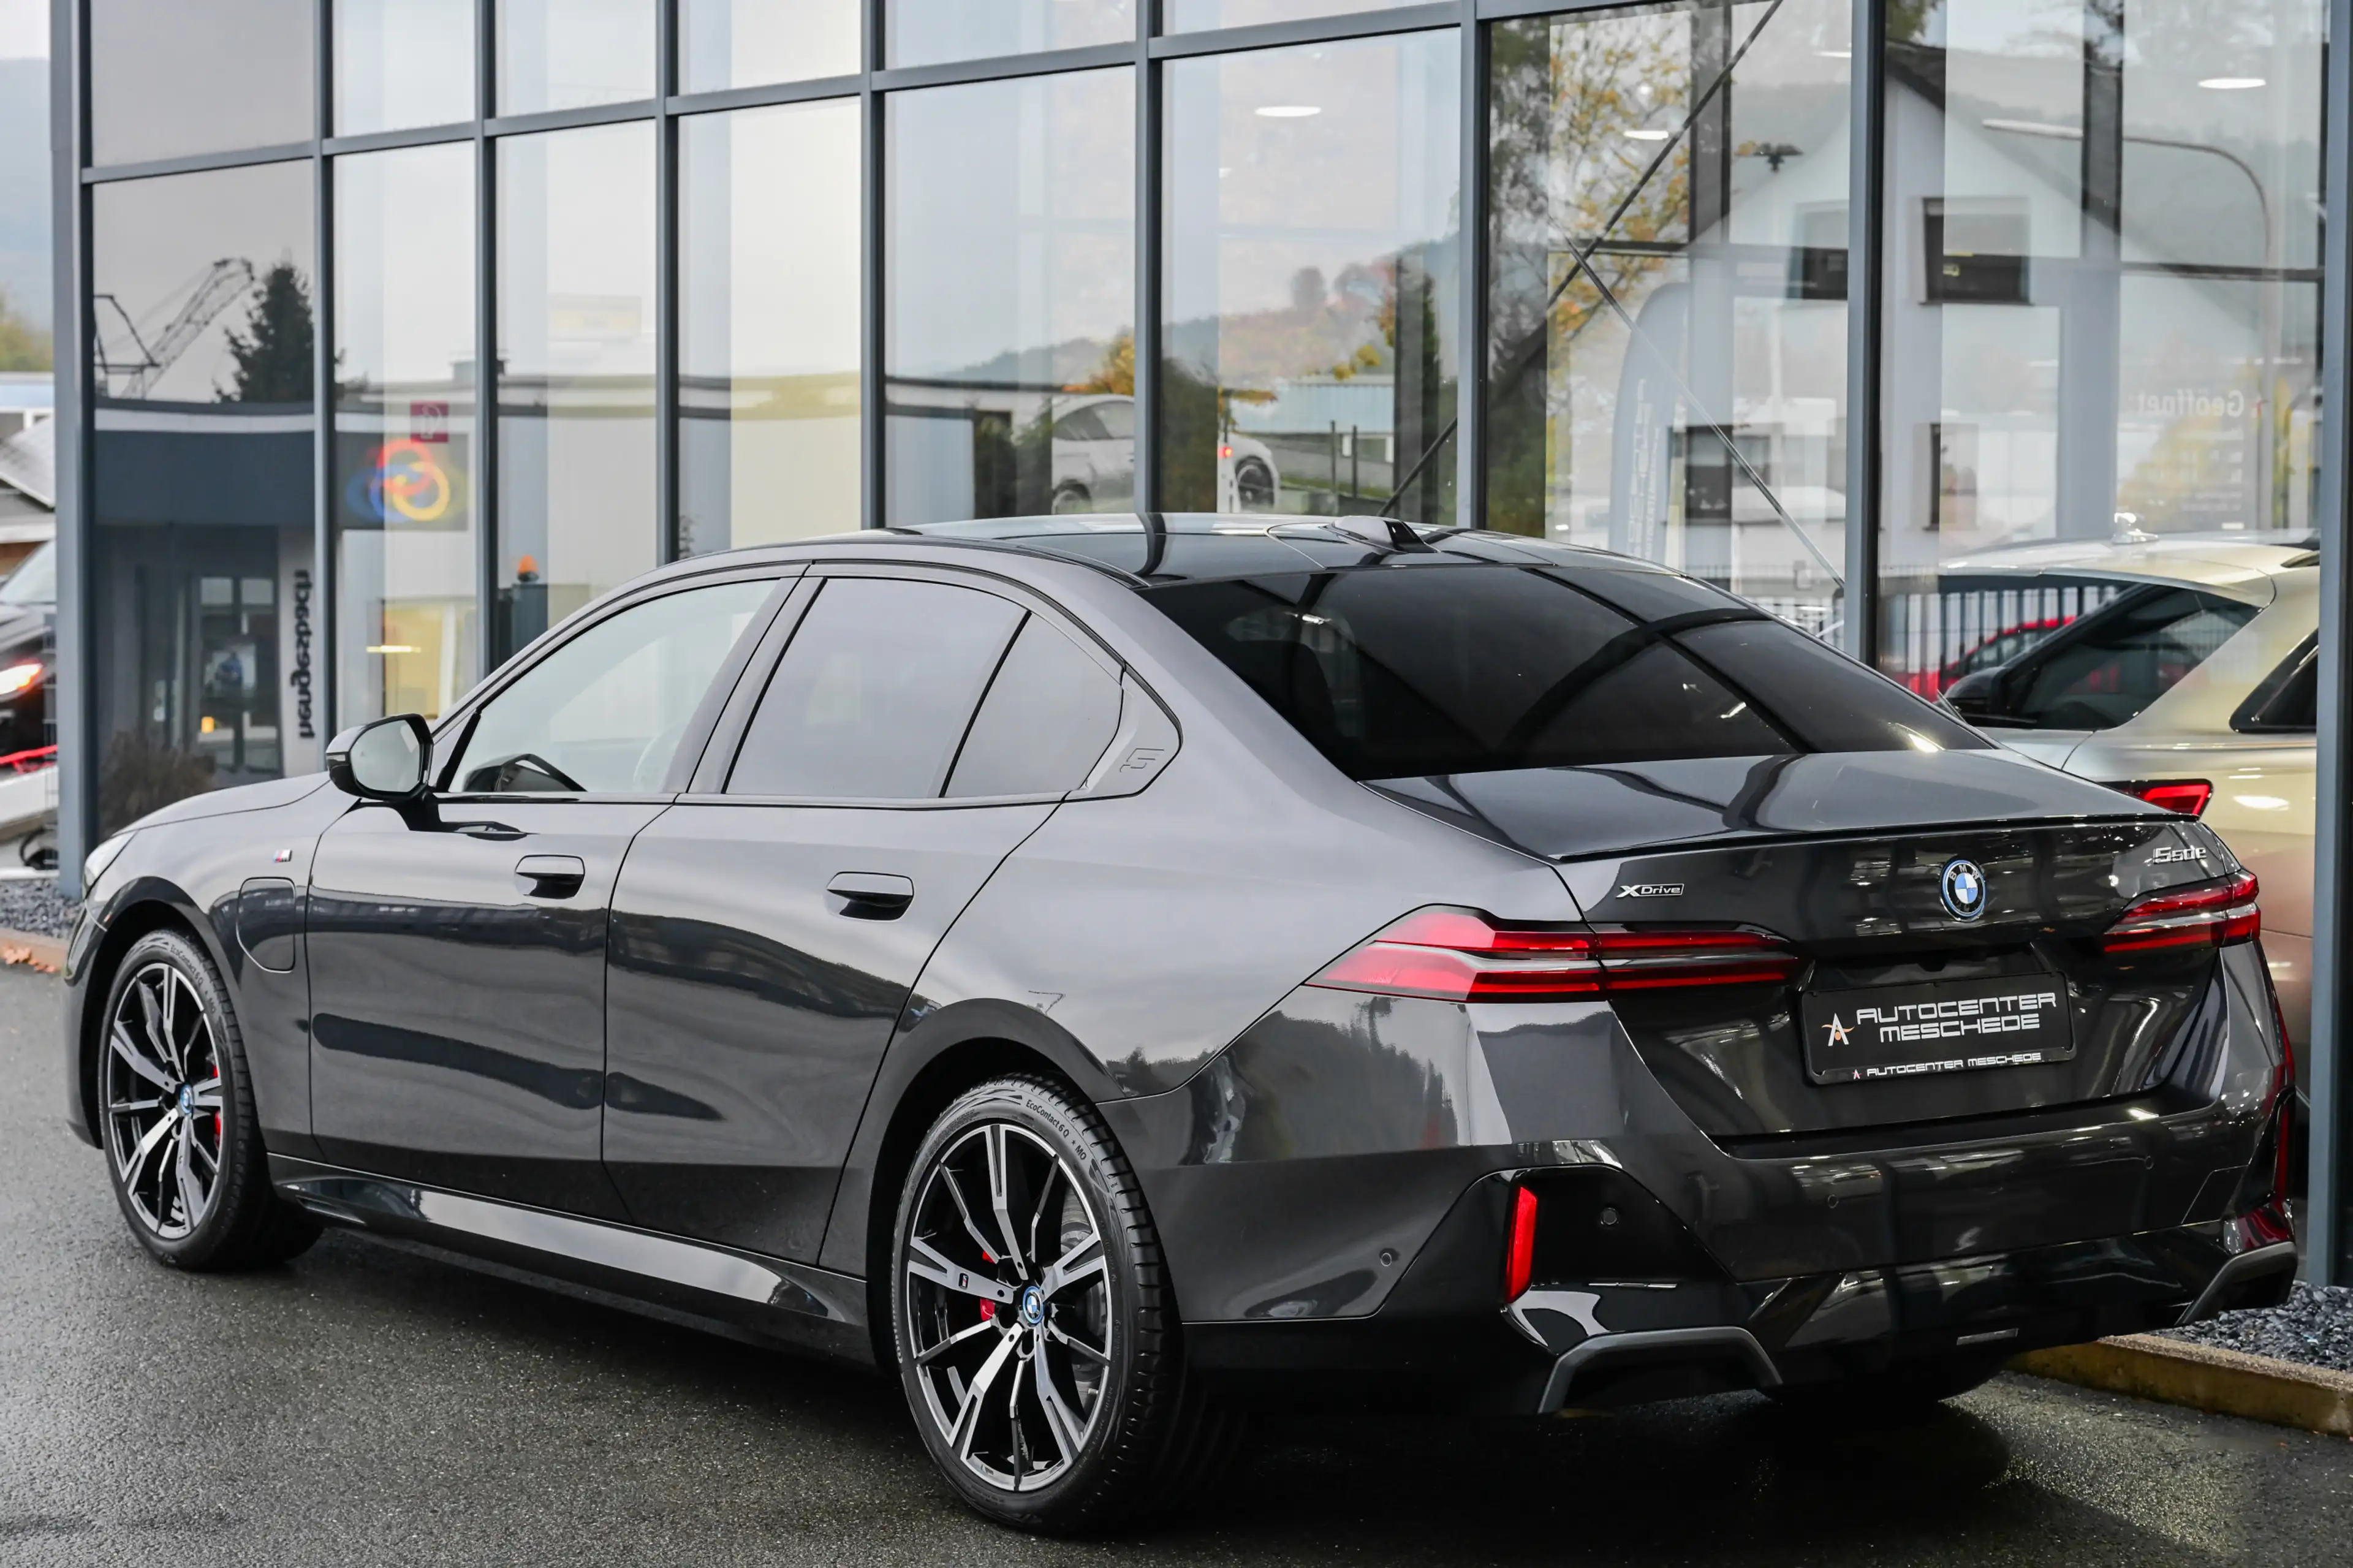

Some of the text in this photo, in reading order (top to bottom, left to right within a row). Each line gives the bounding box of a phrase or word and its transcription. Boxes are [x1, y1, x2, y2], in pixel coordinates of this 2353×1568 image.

[1949, 865, 1980, 881] BMW
[1856, 993, 2056, 1025] AUTOCENTER
[1880, 1013, 2040, 1043] MESCHEDE
[1866, 1053, 2042, 1077] AUTOCENTER MESCHEDE
[1026, 1099, 1059, 1128] EcoContact
[1063, 1129, 1070, 1138] Q
[1075, 1145, 1087, 1160] MO
